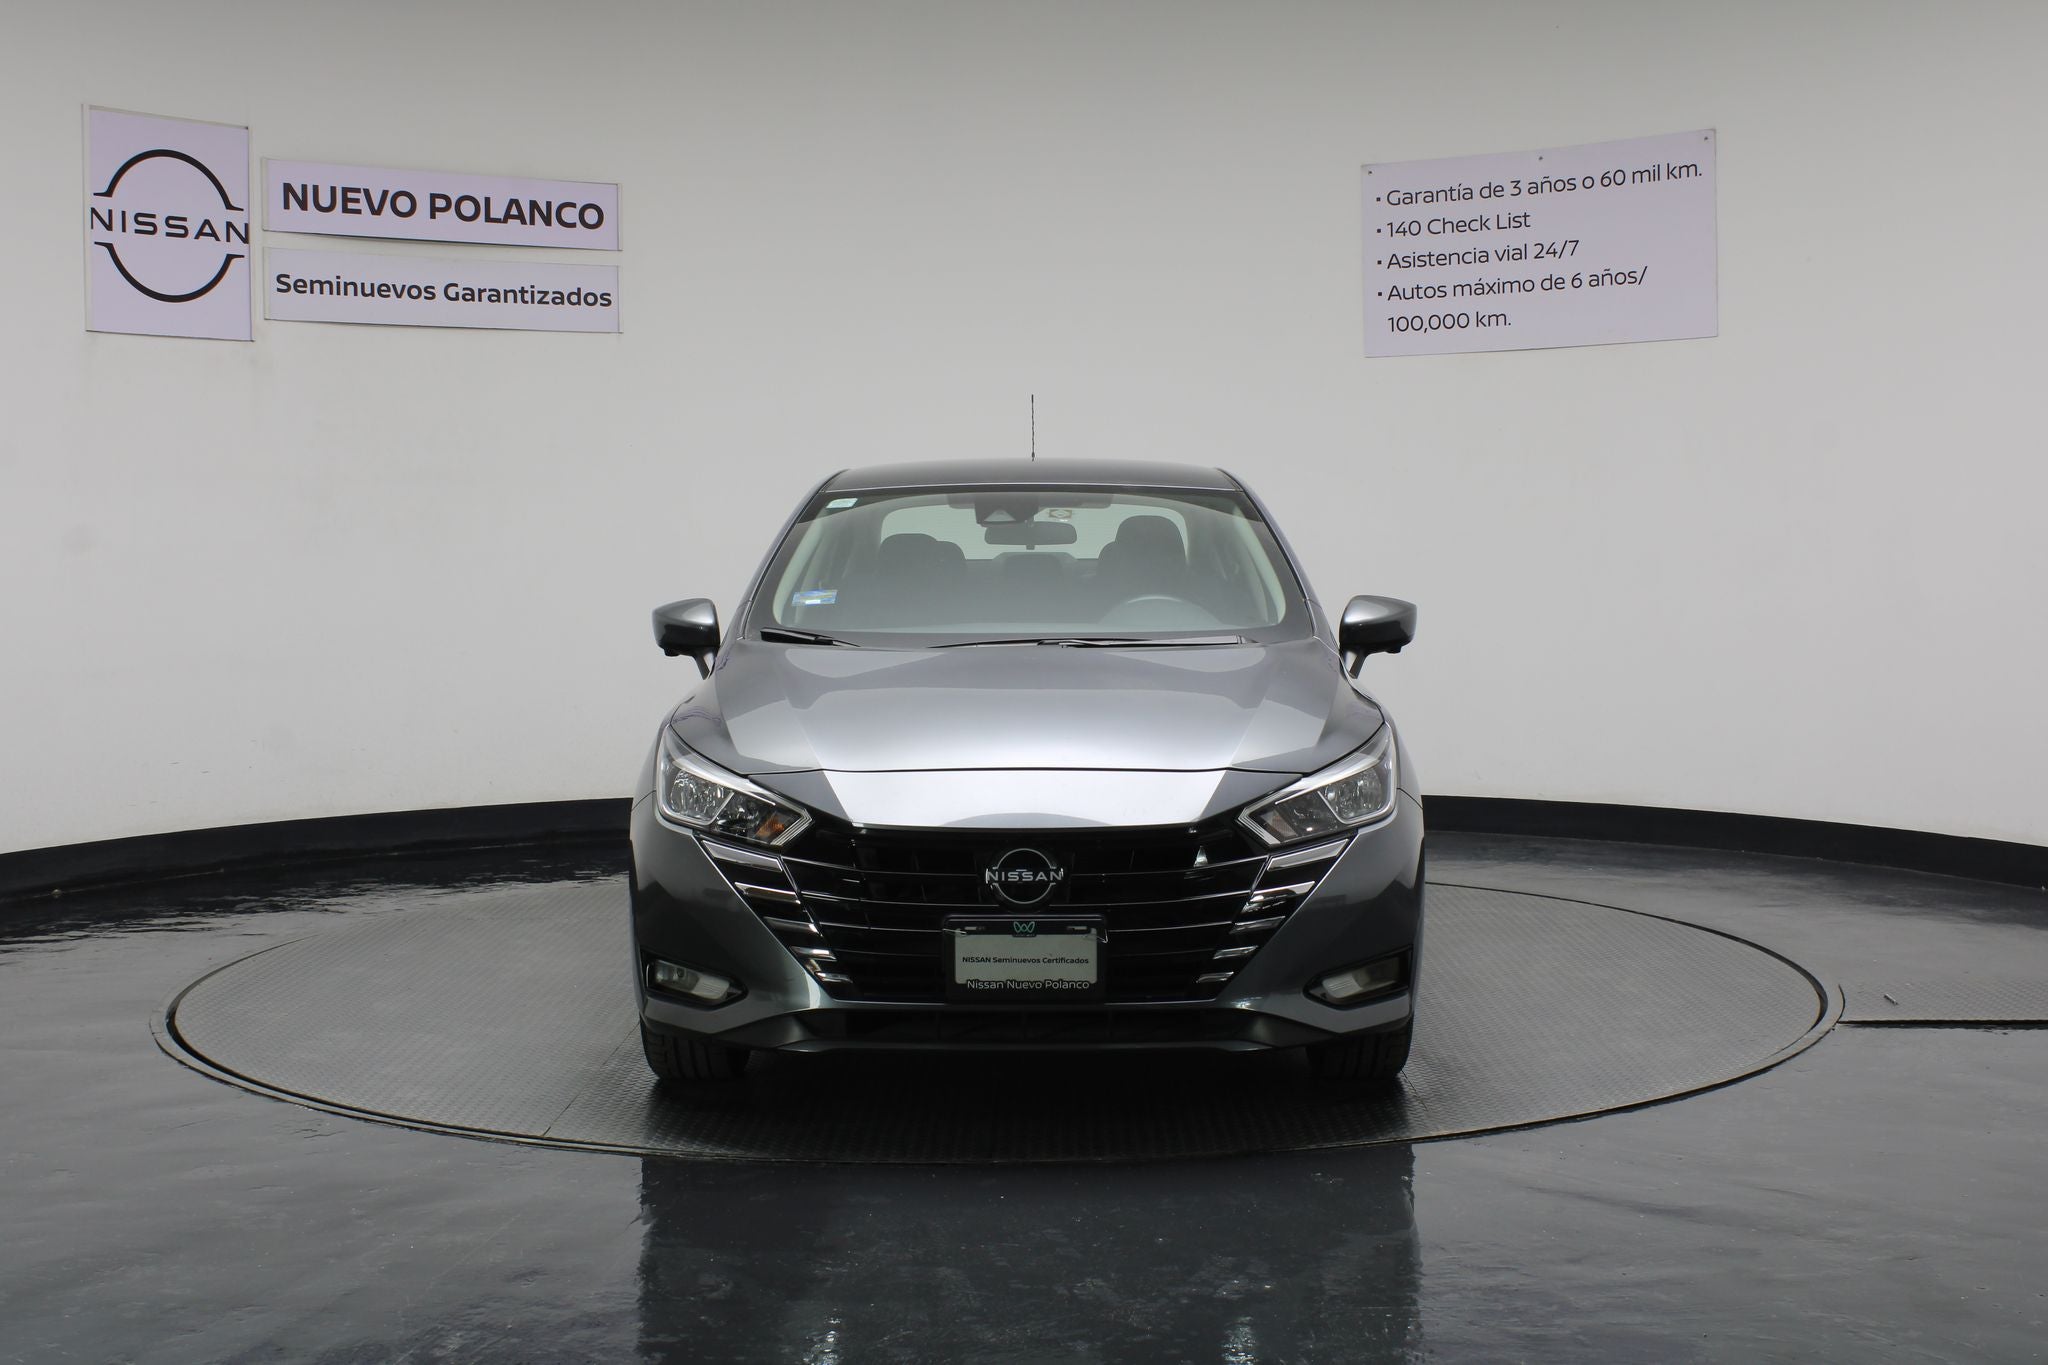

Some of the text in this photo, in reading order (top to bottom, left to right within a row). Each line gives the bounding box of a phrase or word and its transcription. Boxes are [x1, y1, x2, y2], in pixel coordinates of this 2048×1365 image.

[1386, 162, 1703, 206] Garantía de 3 años o 60 mil km.
[282, 182, 605, 230] NUEVO POLANCO
[90, 206, 250, 245] NISSAN
[1386, 211, 1531, 238] 140 Check List
[1386, 239, 1580, 270] Asistencia vial 24/7
[275, 273, 613, 308] Seminuevos Garantizados
[1387, 265, 1648, 302] Autos máximo de 6 años/
[1387, 311, 1512, 334] 100,000 km.
[987, 871, 1062, 882] NISSAN
[962, 956, 991, 964] NISSAN
[1042, 957, 1089, 965] Certificados
[967, 980, 1090, 990] Nissan Nuevo Polanco
